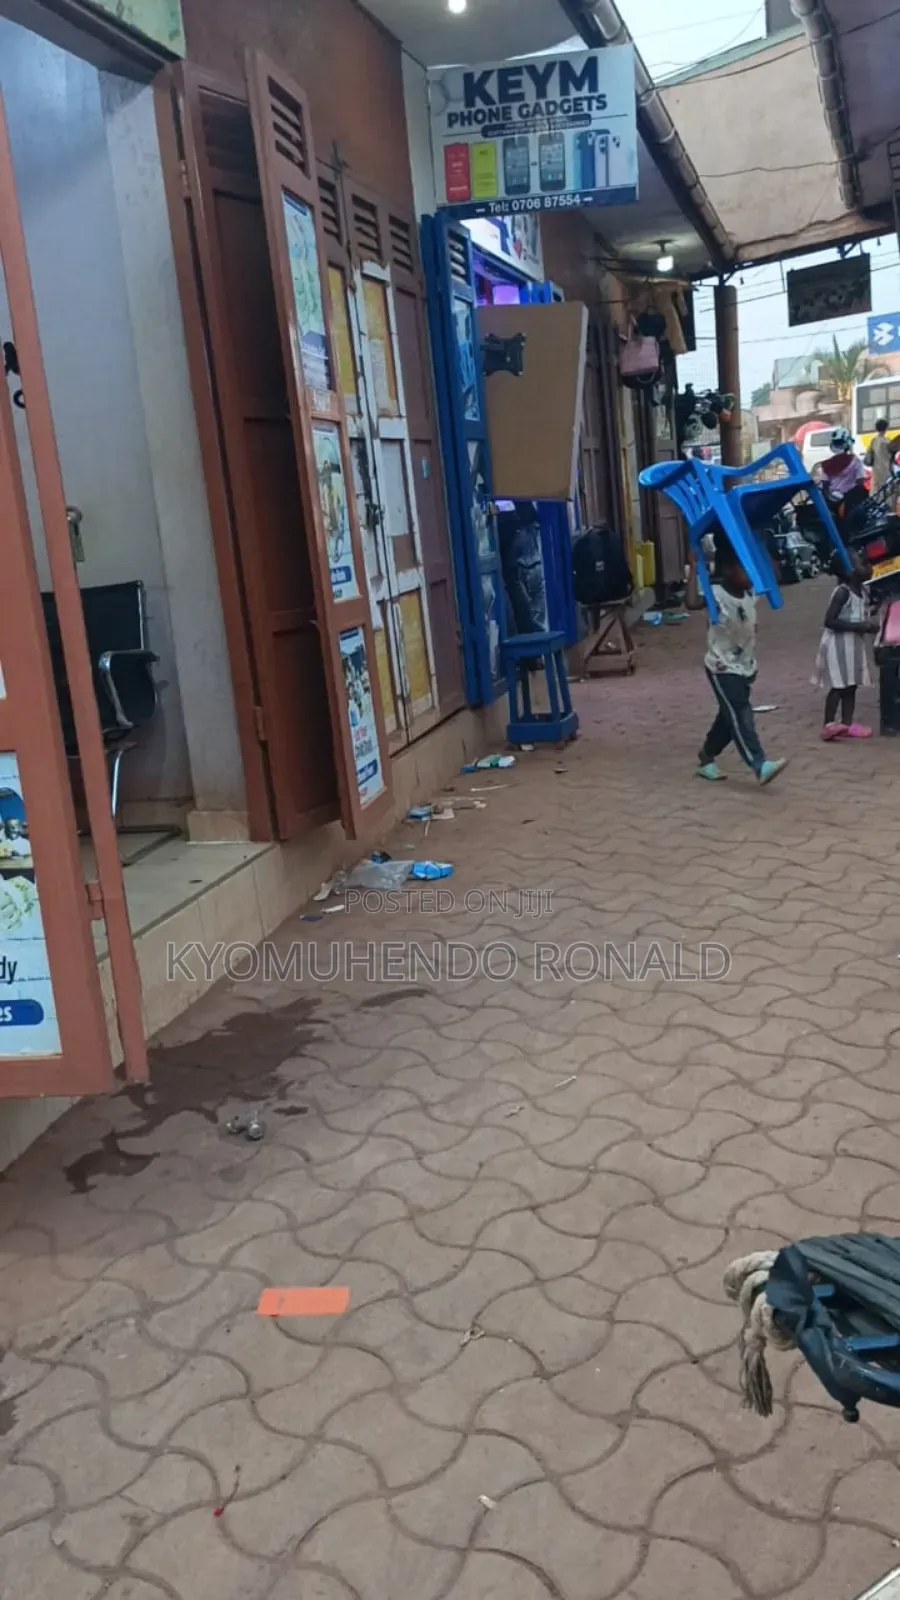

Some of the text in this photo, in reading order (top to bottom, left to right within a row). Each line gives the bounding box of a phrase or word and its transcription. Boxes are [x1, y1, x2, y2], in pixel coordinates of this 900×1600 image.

[463, 56, 599, 108] KEYM
[448, 106, 513, 127] PHONE
[518, 95, 607, 117] GADGETS
[489, 203, 509, 214] Tel:
